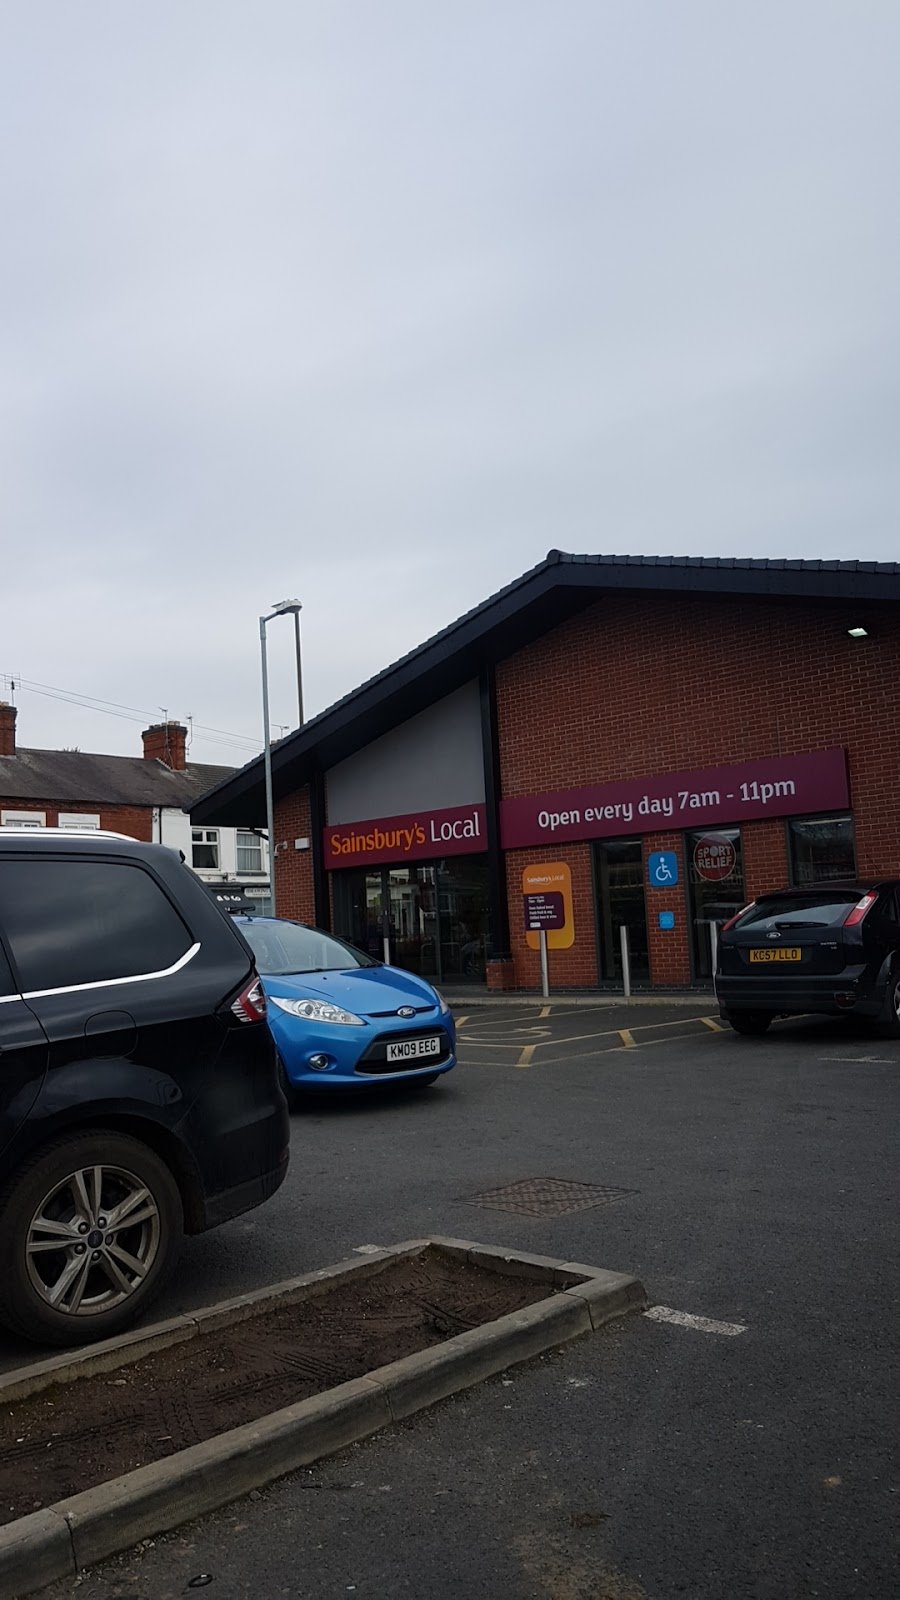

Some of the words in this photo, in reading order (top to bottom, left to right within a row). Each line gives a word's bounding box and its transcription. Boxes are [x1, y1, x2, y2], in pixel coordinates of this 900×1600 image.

[538, 810, 580, 831] Open
[584, 802, 633, 822] every
[638, 795, 673, 817] day
[678, 790, 720, 810] 7am
[740, 779, 796, 804] 11pm
[330, 822, 426, 856] Sainsbury's
[430, 811, 481, 842] Local
[697, 845, 732, 858] SPORT
[698, 856, 732, 869] RELIEF
[779, 949, 798, 960] LLO
[390, 1042, 417, 1059] KM09
[419, 1039, 436, 1054] EEG
